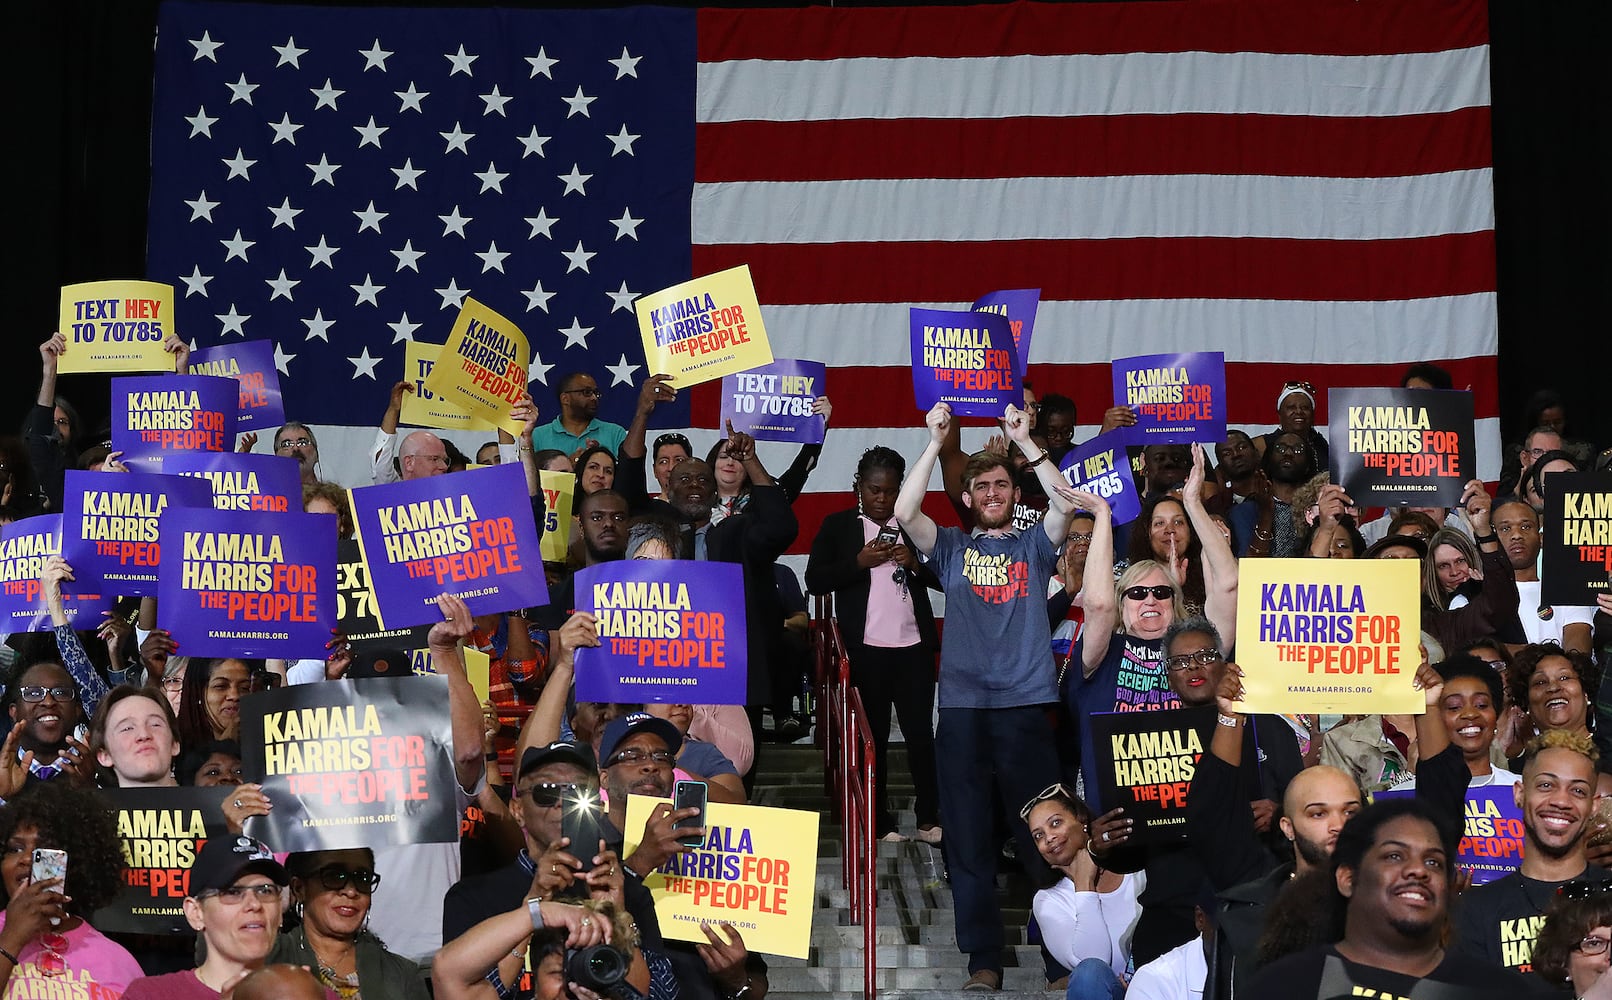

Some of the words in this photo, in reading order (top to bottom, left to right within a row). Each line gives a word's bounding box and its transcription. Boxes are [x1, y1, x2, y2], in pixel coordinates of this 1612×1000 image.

[74, 300, 119, 320] TEXT
[126, 299, 161, 318] HEY
[650, 292, 716, 328] KAMALA
[72, 323, 96, 343] TO
[101, 322, 162, 342] 70785
[654, 313, 713, 347] HARRIS
[711, 305, 744, 330] FOR
[924, 326, 992, 348] KAMALA
[466, 318, 517, 361] KAMALA
[668, 340, 688, 356] THE
[688, 324, 750, 357] PEOPLE
[458, 336, 508, 376] HARRIS
[504, 361, 526, 390] FOR
[461, 358, 478, 376] THE
[682, 354, 735, 373] KAMALAHARRIS.ORG
[924, 346, 986, 370] HARRIS
[985, 350, 1010, 370] FOR
[736, 374, 777, 393] TEXT
[781, 376, 814, 395] HEY
[934, 368, 952, 380] THE
[954, 370, 1014, 390] PEOPLE
[1126, 368, 1189, 387] KAMALA
[128, 391, 200, 411] KAMALA
[734, 394, 755, 413] TO
[760, 396, 814, 416] 70785
[1128, 386, 1183, 404] HARRIS
[1183, 384, 1212, 402] FOR
[128, 410, 193, 430] HARRIS
[193, 411, 224, 432] FOR
[1139, 404, 1157, 415] THE
[1157, 403, 1212, 421] PEOPLE
[1348, 406, 1430, 430] KAMALA
[140, 430, 160, 442] THE
[162, 430, 224, 452] PEOPLE
[1348, 430, 1422, 454] HARRIS
[1422, 431, 1459, 454] FOR
[1084, 449, 1114, 479] HEY
[1363, 454, 1386, 467] THE
[1386, 454, 1460, 477] PEOPLE
[84, 491, 168, 517] KAMALA
[378, 494, 478, 535] KAMALA
[1564, 493, 1612, 518] KAM
[82, 516, 160, 542] HARRIS
[384, 524, 472, 564] HARRIS
[470, 516, 516, 549] FOR
[1564, 520, 1612, 546] HAR
[96, 542, 120, 556] THE
[120, 542, 160, 566] PEO
[183, 532, 284, 563] KAMALA
[1578, 546, 1604, 561] THE
[182, 561, 273, 592] HARRIS
[274, 564, 316, 592] FOR
[406, 560, 434, 578] THE
[434, 544, 522, 585] PEOPLE
[4, 580, 25, 594] THE
[594, 582, 692, 610] KAMALA
[1261, 584, 1366, 613] KAMALA
[199, 591, 227, 610] THE
[228, 592, 317, 622] PEOPLE
[208, 631, 288, 640] KAMALAHARRIS.ORG
[595, 609, 680, 638] HARRIS
[680, 612, 724, 640] FOR
[1260, 614, 1354, 643] HARRIS
[1356, 616, 1400, 644] FOR
[611, 638, 637, 655] THE
[638, 640, 724, 668] PEOPLE
[1120, 658, 1132, 670] NO
[1278, 645, 1306, 662] THE
[1308, 646, 1400, 674] PEOPLE
[620, 676, 698, 686] KAMALAHARRIS.ORG
[1288, 686, 1373, 694] KAMALAHARRIS.ORG
[1116, 687, 1132, 702] GOD
[264, 705, 382, 744] KAMALA
[265, 738, 372, 775] HARRIS
[371, 736, 427, 769] FOR
[1112, 728, 1204, 760] KAMALA
[1114, 756, 1196, 786] HARRIS
[287, 772, 322, 795] THE
[322, 768, 428, 806] PEOPLE
[1132, 786, 1159, 801] THE
[118, 810, 207, 838] AMALA
[302, 814, 397, 828] KAMALAHARRIS.ORG
[1494, 819, 1525, 838] FO
[701, 826, 754, 854] ALA
[121, 840, 196, 868] ARRIS
[122, 868, 148, 886] HE
[742, 856, 790, 886] FOR
[664, 876, 692, 894] THE
[693, 880, 788, 915] PEOPLE
